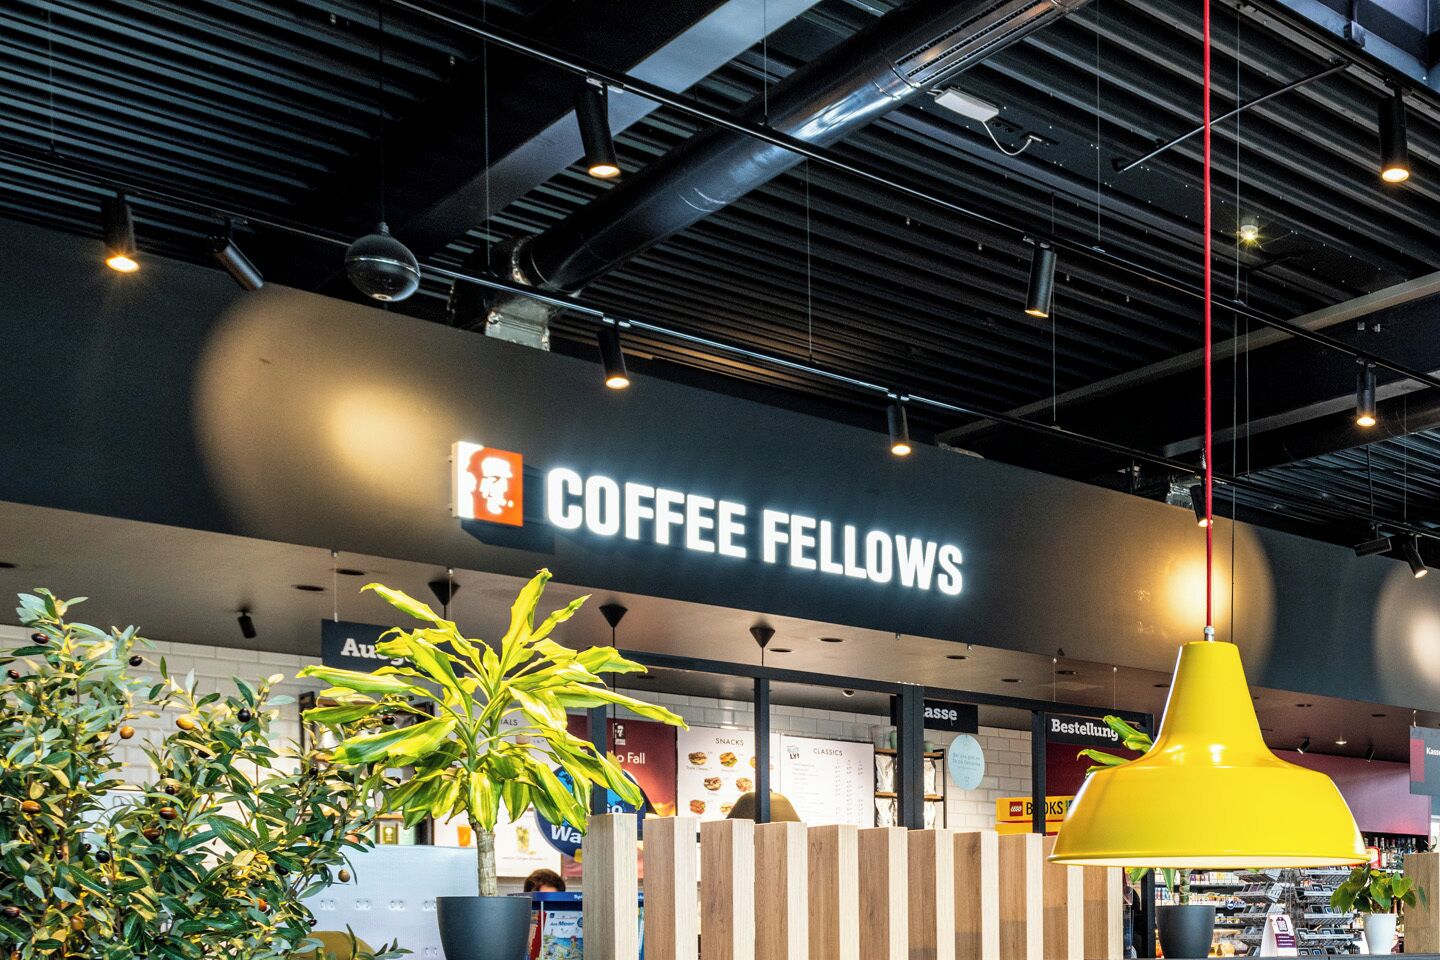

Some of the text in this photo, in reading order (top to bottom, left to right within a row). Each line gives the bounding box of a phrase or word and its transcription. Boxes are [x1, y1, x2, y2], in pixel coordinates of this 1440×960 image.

[546, 467, 963, 596] COFFEE FELLOWS
[922, 705, 958, 721] asse
[1051, 718, 1119, 741] Bestellung
[715, 737, 744, 747] SNACKS
[627, 752, 646, 765] Fall
[813, 747, 843, 757] CLASSICS
[1026, 801, 1064, 816] BOKS
